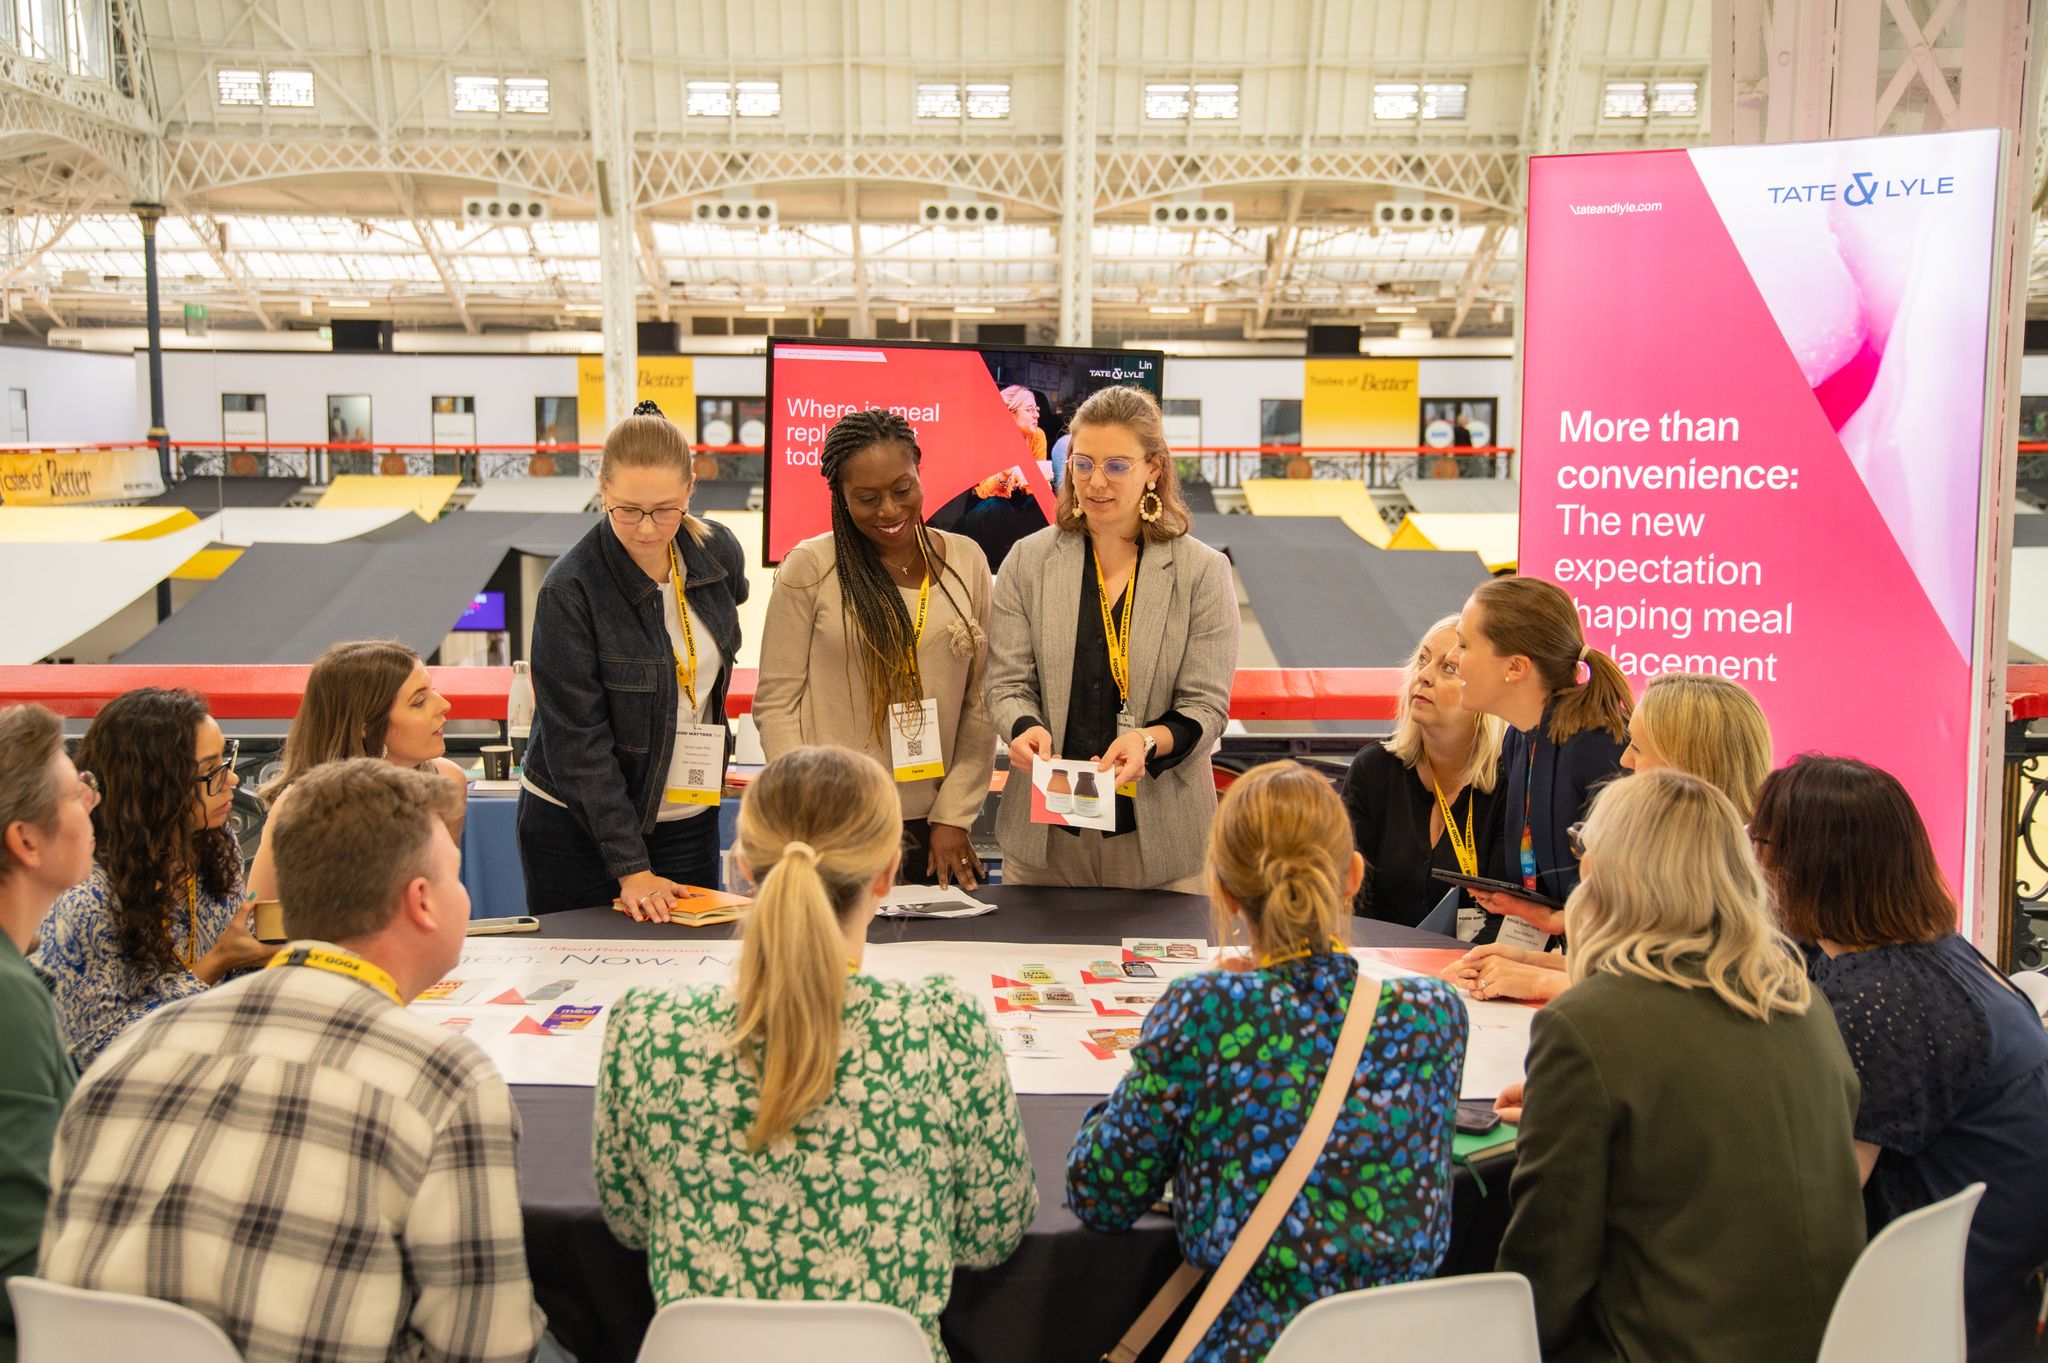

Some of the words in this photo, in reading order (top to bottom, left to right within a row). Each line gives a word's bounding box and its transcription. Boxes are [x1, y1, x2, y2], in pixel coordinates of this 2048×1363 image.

[1767, 183, 1837, 204] TATE
[1843, 171, 1879, 207] &
[1886, 176, 1954, 198] LYLE
[1089, 369, 1111, 378] TATE
[1138, 360, 1152, 370] Lin
[1560, 410, 1650, 442] More
[1659, 409, 1739, 442] than
[46, 459, 92, 496] Better
[1557, 457, 1799, 490] convenience:
[1556, 504, 1622, 536] The
[1632, 512, 1705, 537] new
[1554, 552, 1762, 590] expectation
[681, 601, 691, 635] MATTERS
[919, 597, 927, 629] MATTERS
[1103, 603, 1113, 635] MATTERS
[1122, 603, 1130, 636] MATTERS
[1574, 597, 1692, 640] haping
[1703, 602, 1793, 635] meal
[687, 636, 695, 657] FOOD
[1611, 644, 1778, 682] lacement
[1451, 828, 1461, 847] FOOD
[560, 953, 679, 966] Now.
